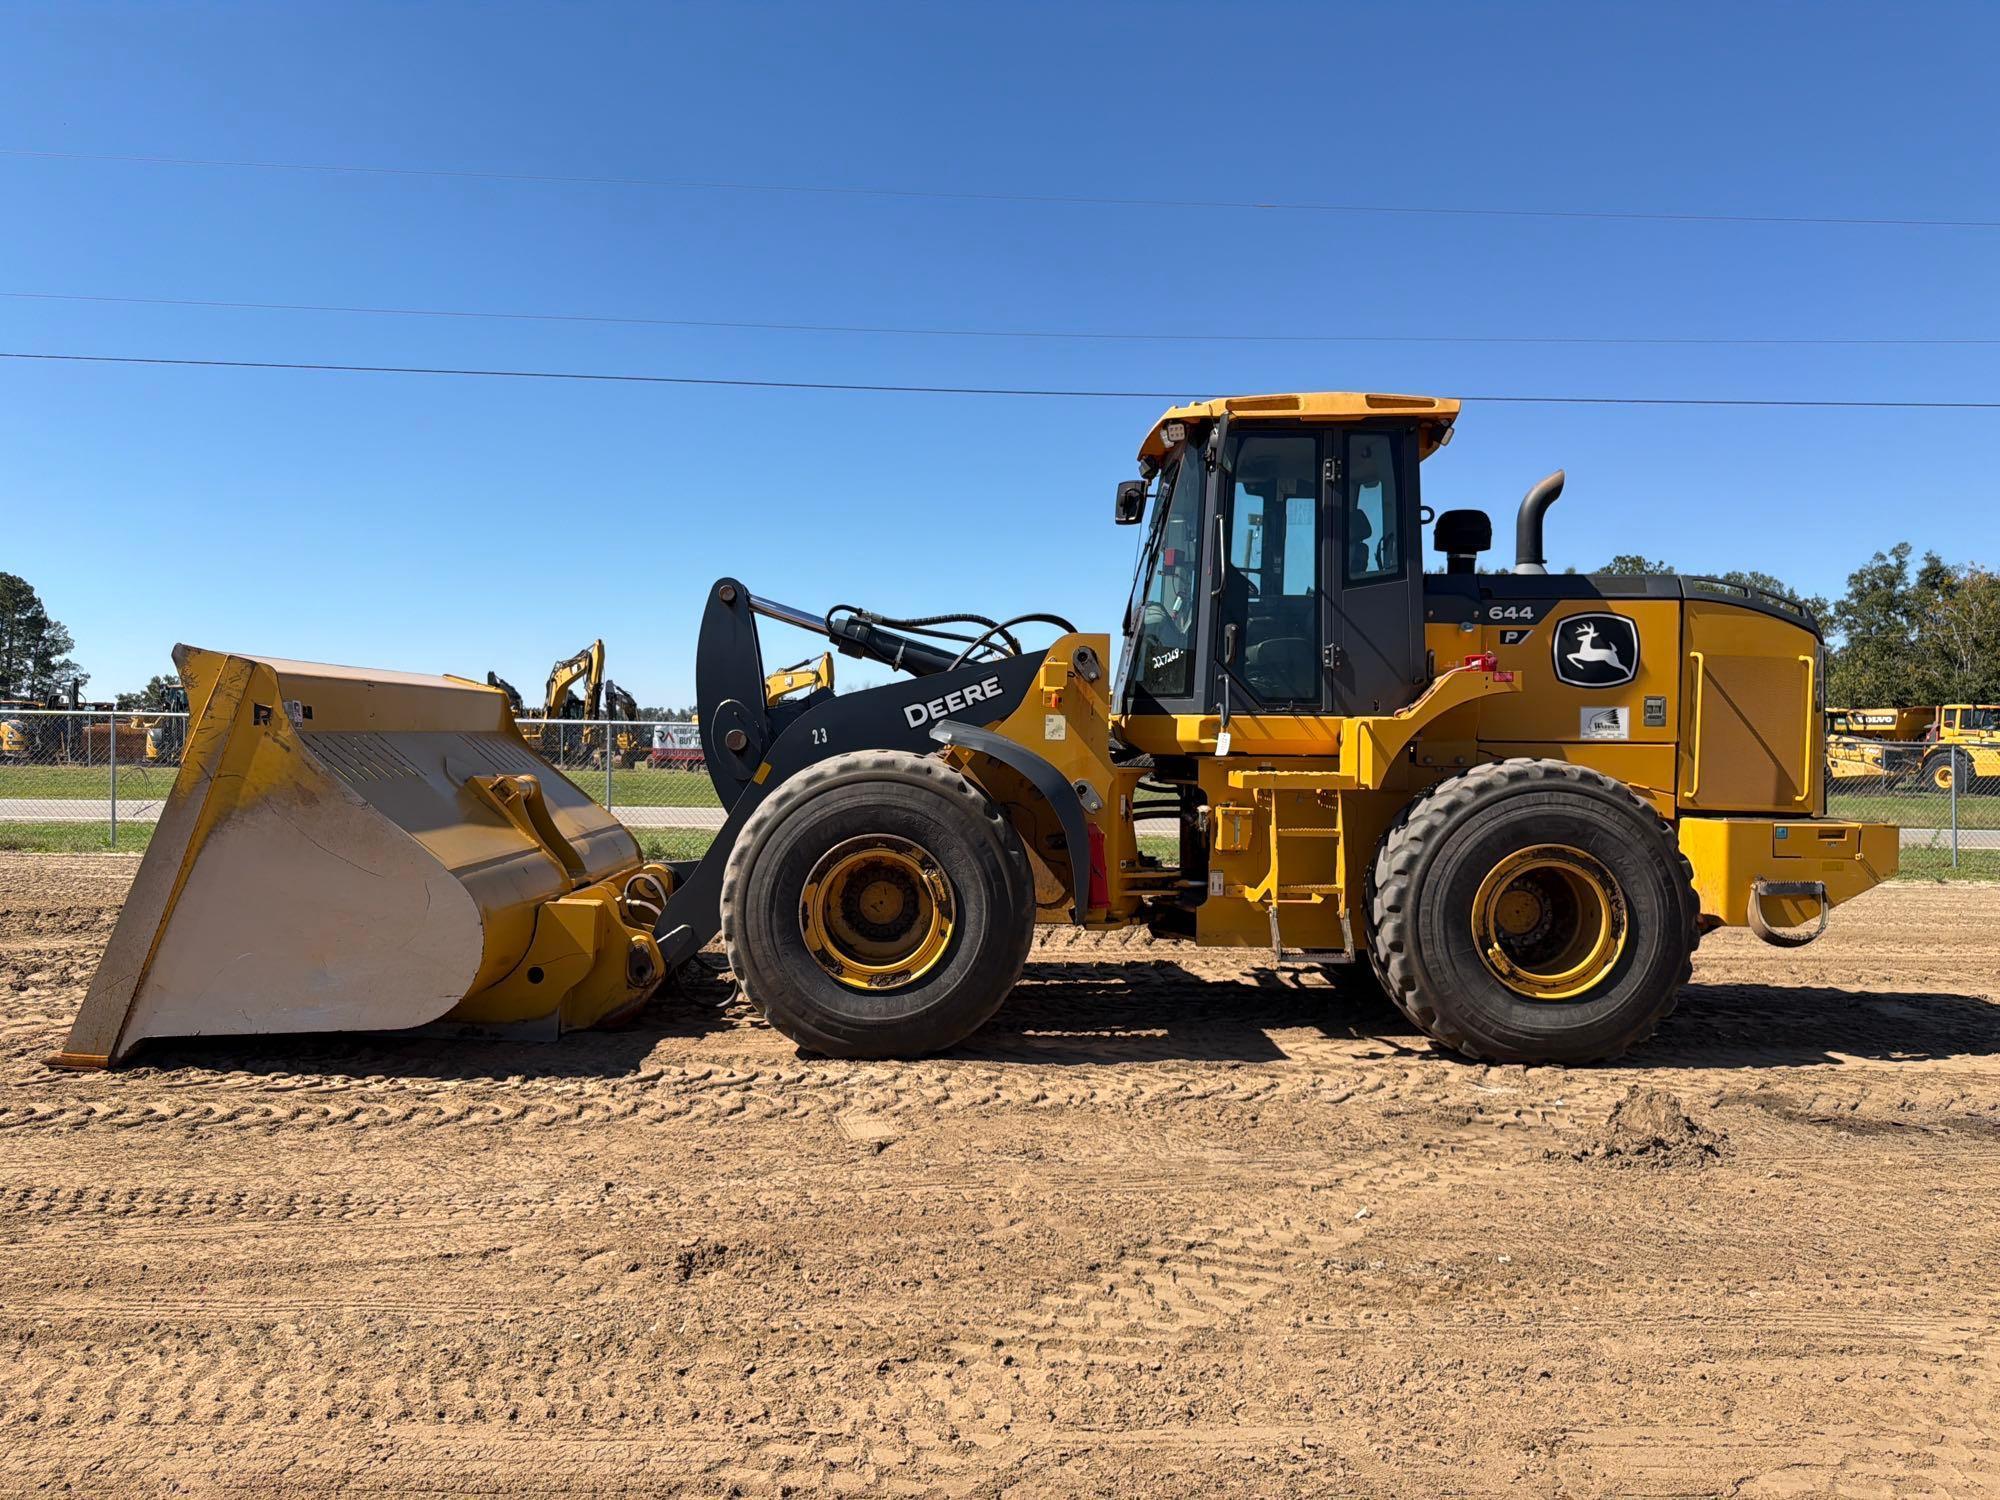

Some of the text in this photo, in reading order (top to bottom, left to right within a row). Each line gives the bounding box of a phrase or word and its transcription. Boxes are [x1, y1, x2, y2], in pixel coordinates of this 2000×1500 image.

[1488, 606, 1534, 620] 644
[1504, 631, 1519, 644] P
[903, 676, 1003, 729] DEERE
[679, 736, 692, 745] BUY
[811, 727, 828, 745] 23
